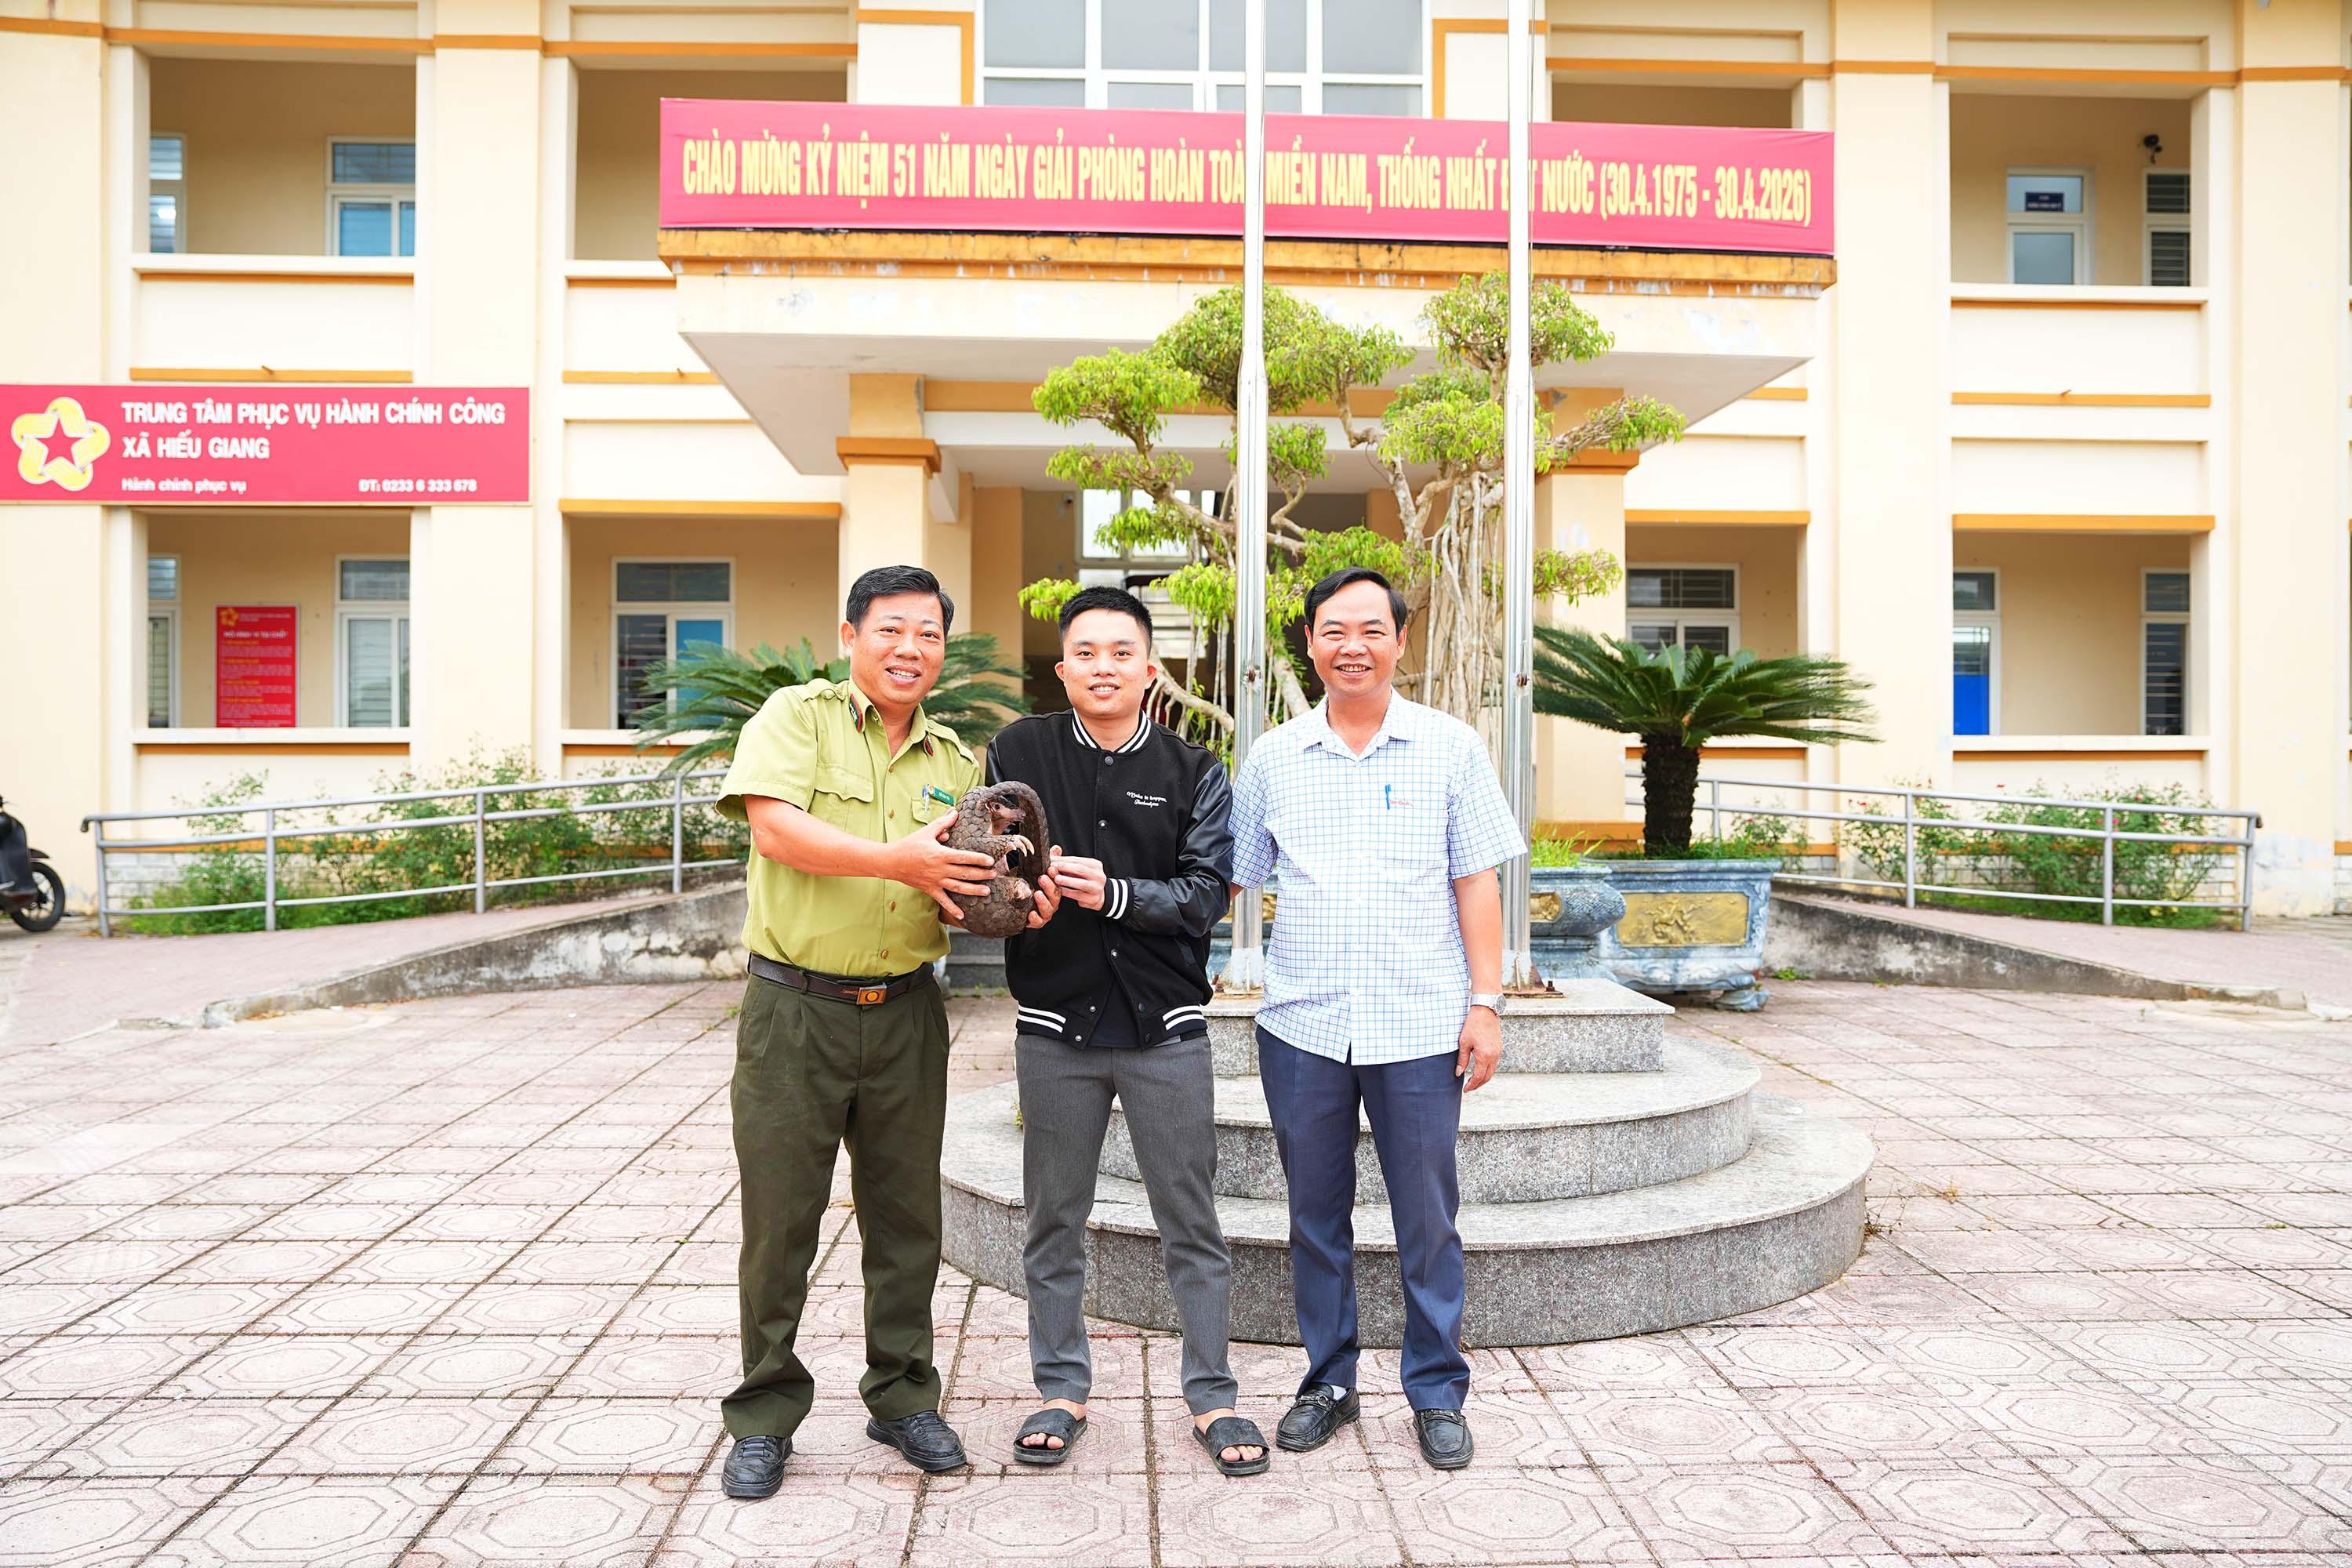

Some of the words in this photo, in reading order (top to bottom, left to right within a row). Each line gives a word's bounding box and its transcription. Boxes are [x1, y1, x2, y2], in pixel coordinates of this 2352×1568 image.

[683, 128, 736, 195] CHÀO
[741, 129, 801, 196] MỪNG
[806, 122, 833, 196] KỶ
[837, 129, 889, 209] NIỆM
[893, 143, 916, 198] 51
[923, 132, 971, 198] NĂM
[975, 132, 1029, 199] NGÀY
[1033, 127, 1073, 200] GIẢI
[1078, 132, 1145, 201] PHÒNG
[1150, 137, 1205, 203] HOÀN
[1208, 138, 1246, 204] TOÀ
[1265, 134, 1317, 205] MIỀN
[1321, 152, 1373, 214] NAM,
[1377, 136, 1441, 209] THỐNG
[1446, 137, 1497, 211] NHẤT
[1500, 157, 1538, 212] ĐT
[1541, 149, 1595, 214] NƯỚC
[1599, 162, 1697, 221] (30.4.1975
[1702, 189, 1711, 201] -
[1715, 165, 1812, 227] 30.4.2026)
[121, 401, 187, 424] TRUNG
[192, 397, 233, 424] TÂM
[237, 402, 289, 430] PHỤC
[294, 403, 321, 430] VỤ
[325, 397, 379, 424] HÀNH
[384, 396, 443, 424] CHÍNH
[448, 396, 506, 425] CÔNG
[122, 431, 151, 459] XÃ
[157, 429, 201, 459] HIẾU
[208, 436, 271, 459] GIANG
[427, 478, 452, 492] 333
